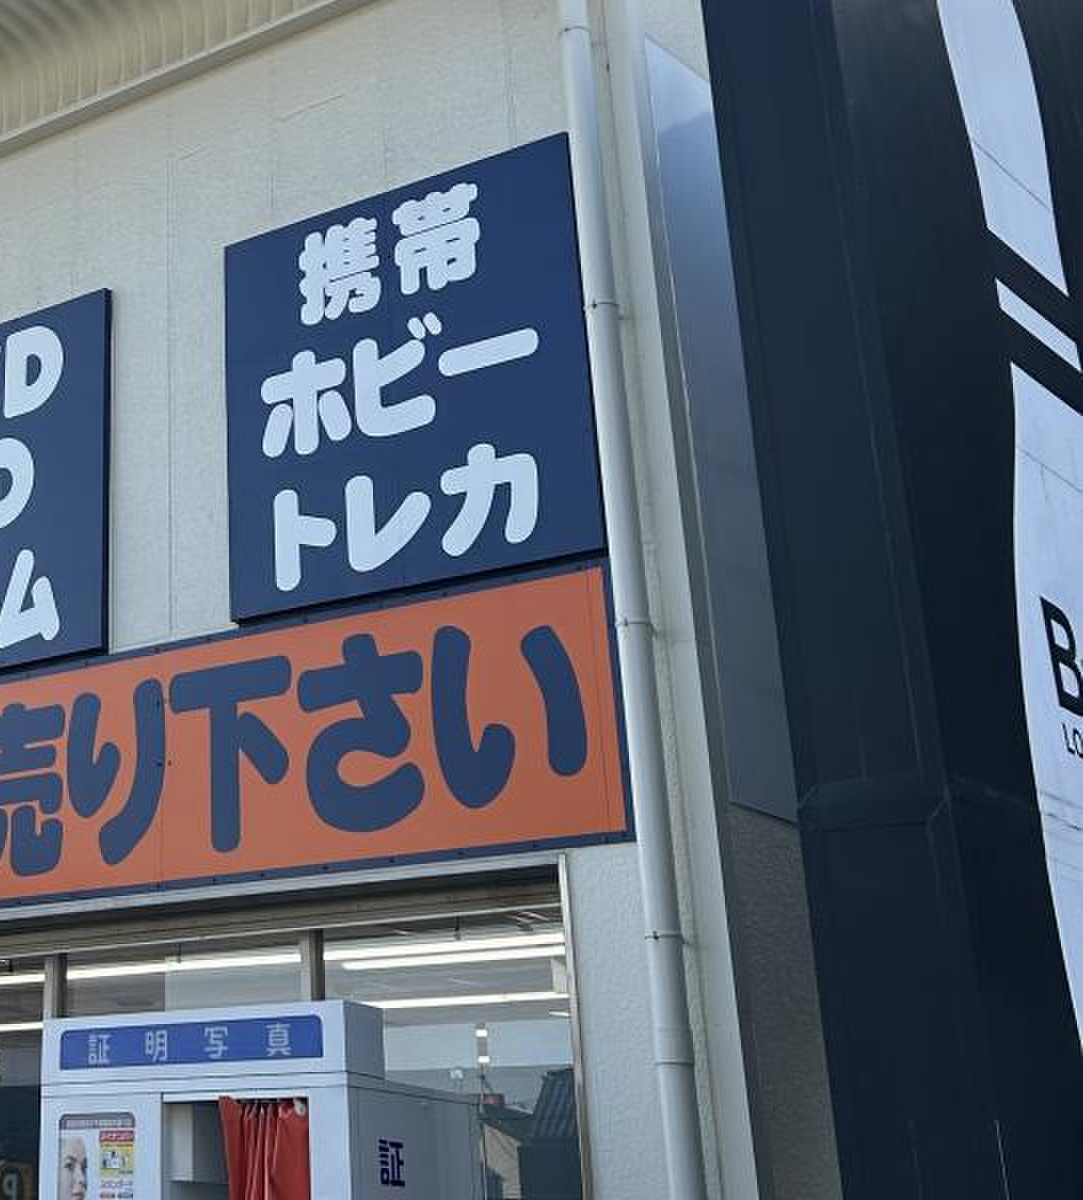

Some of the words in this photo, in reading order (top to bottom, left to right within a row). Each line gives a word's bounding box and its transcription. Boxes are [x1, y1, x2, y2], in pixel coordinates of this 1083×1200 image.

[299, 182, 480, 326] 携帯
[260, 311, 541, 459] ホビー
[272, 443, 540, 592] トレカ
[88, 1023, 293, 1065] 証明写真
